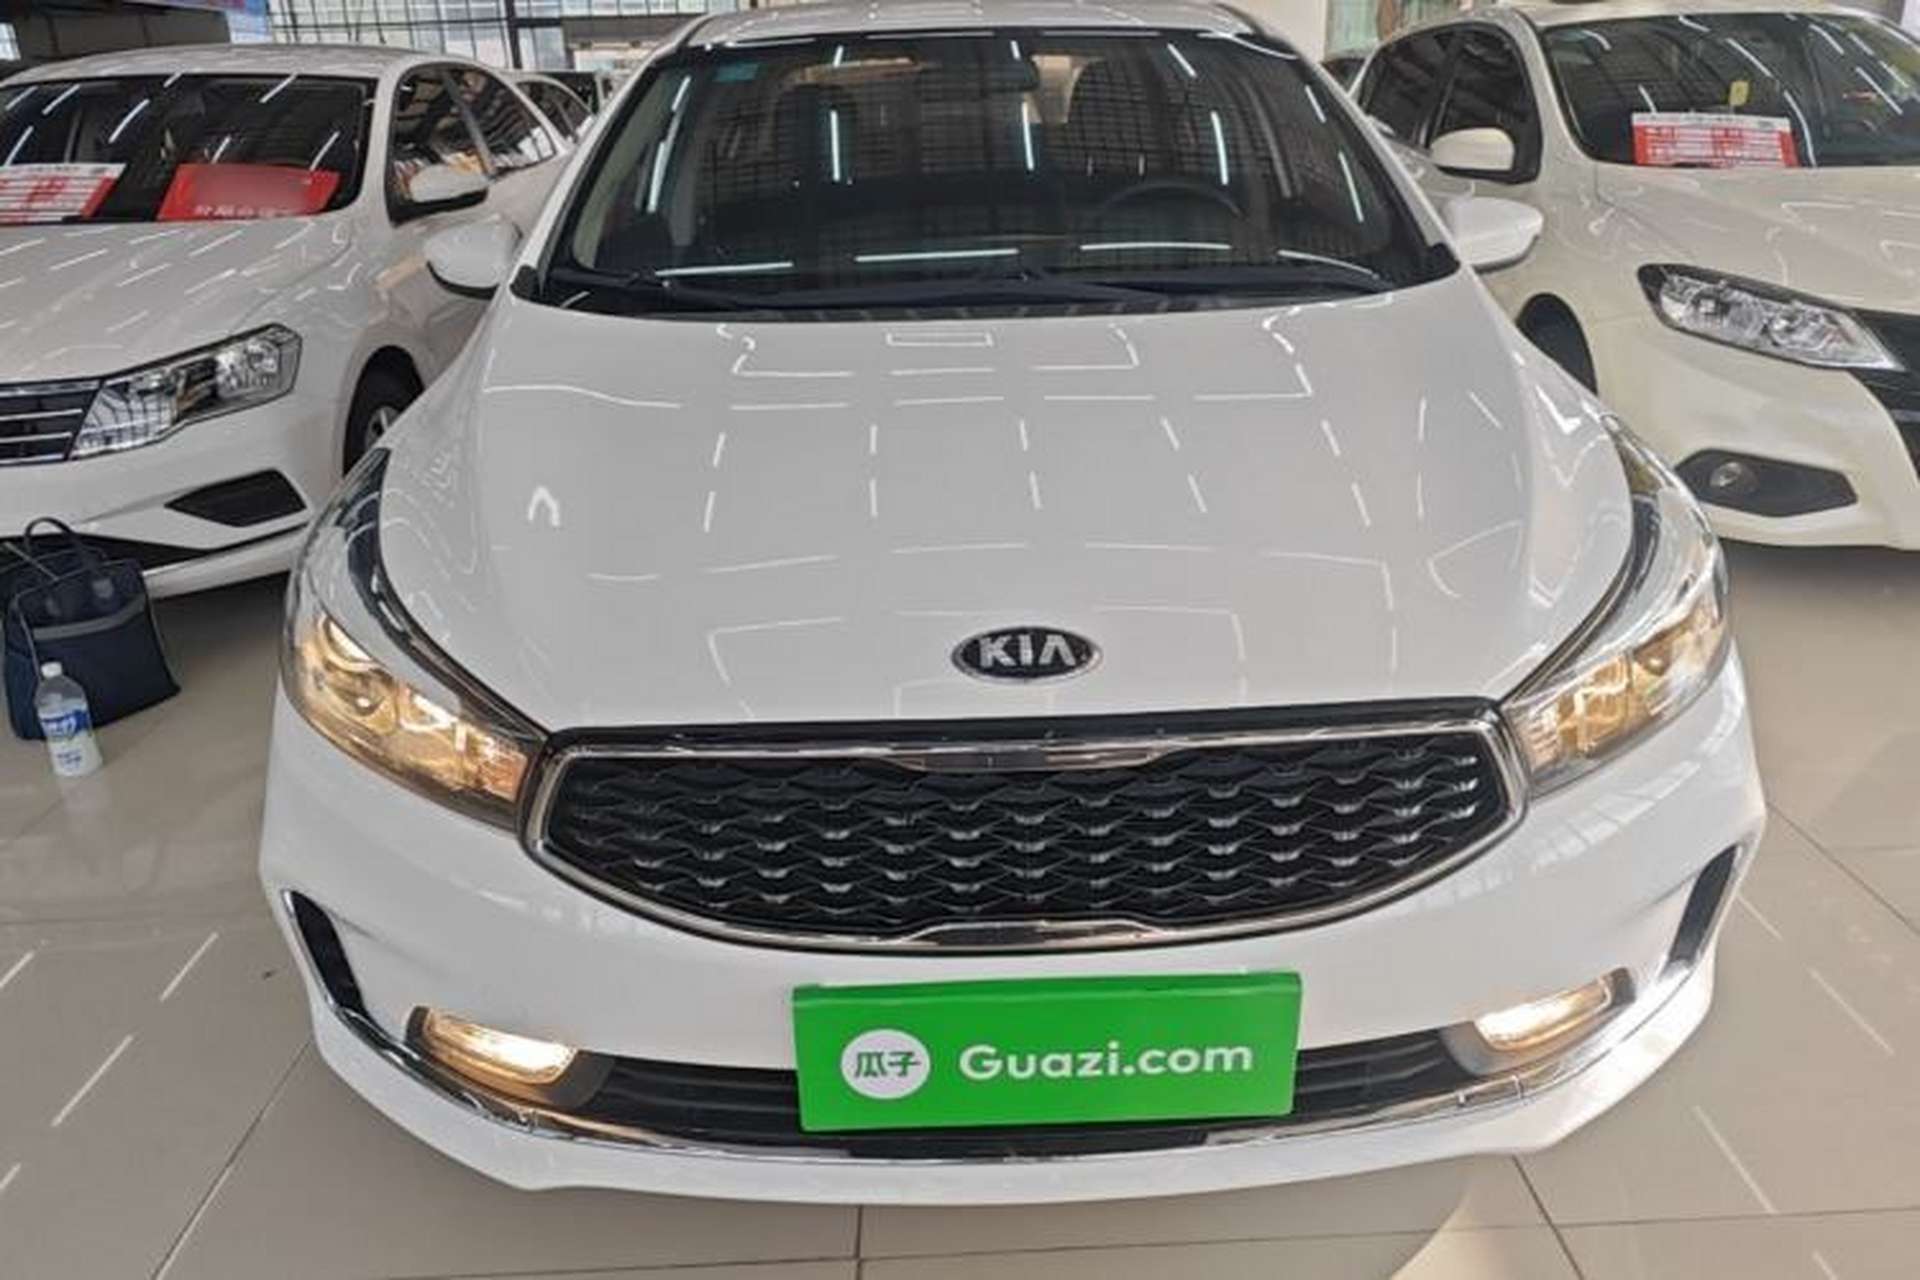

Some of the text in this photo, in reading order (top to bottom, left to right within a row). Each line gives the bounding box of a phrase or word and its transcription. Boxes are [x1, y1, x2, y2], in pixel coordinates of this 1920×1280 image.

[979, 634, 1076, 667] KIA
[854, 1051, 922, 1078] 瓜子
[959, 1040, 1253, 1081] Guazi.com
